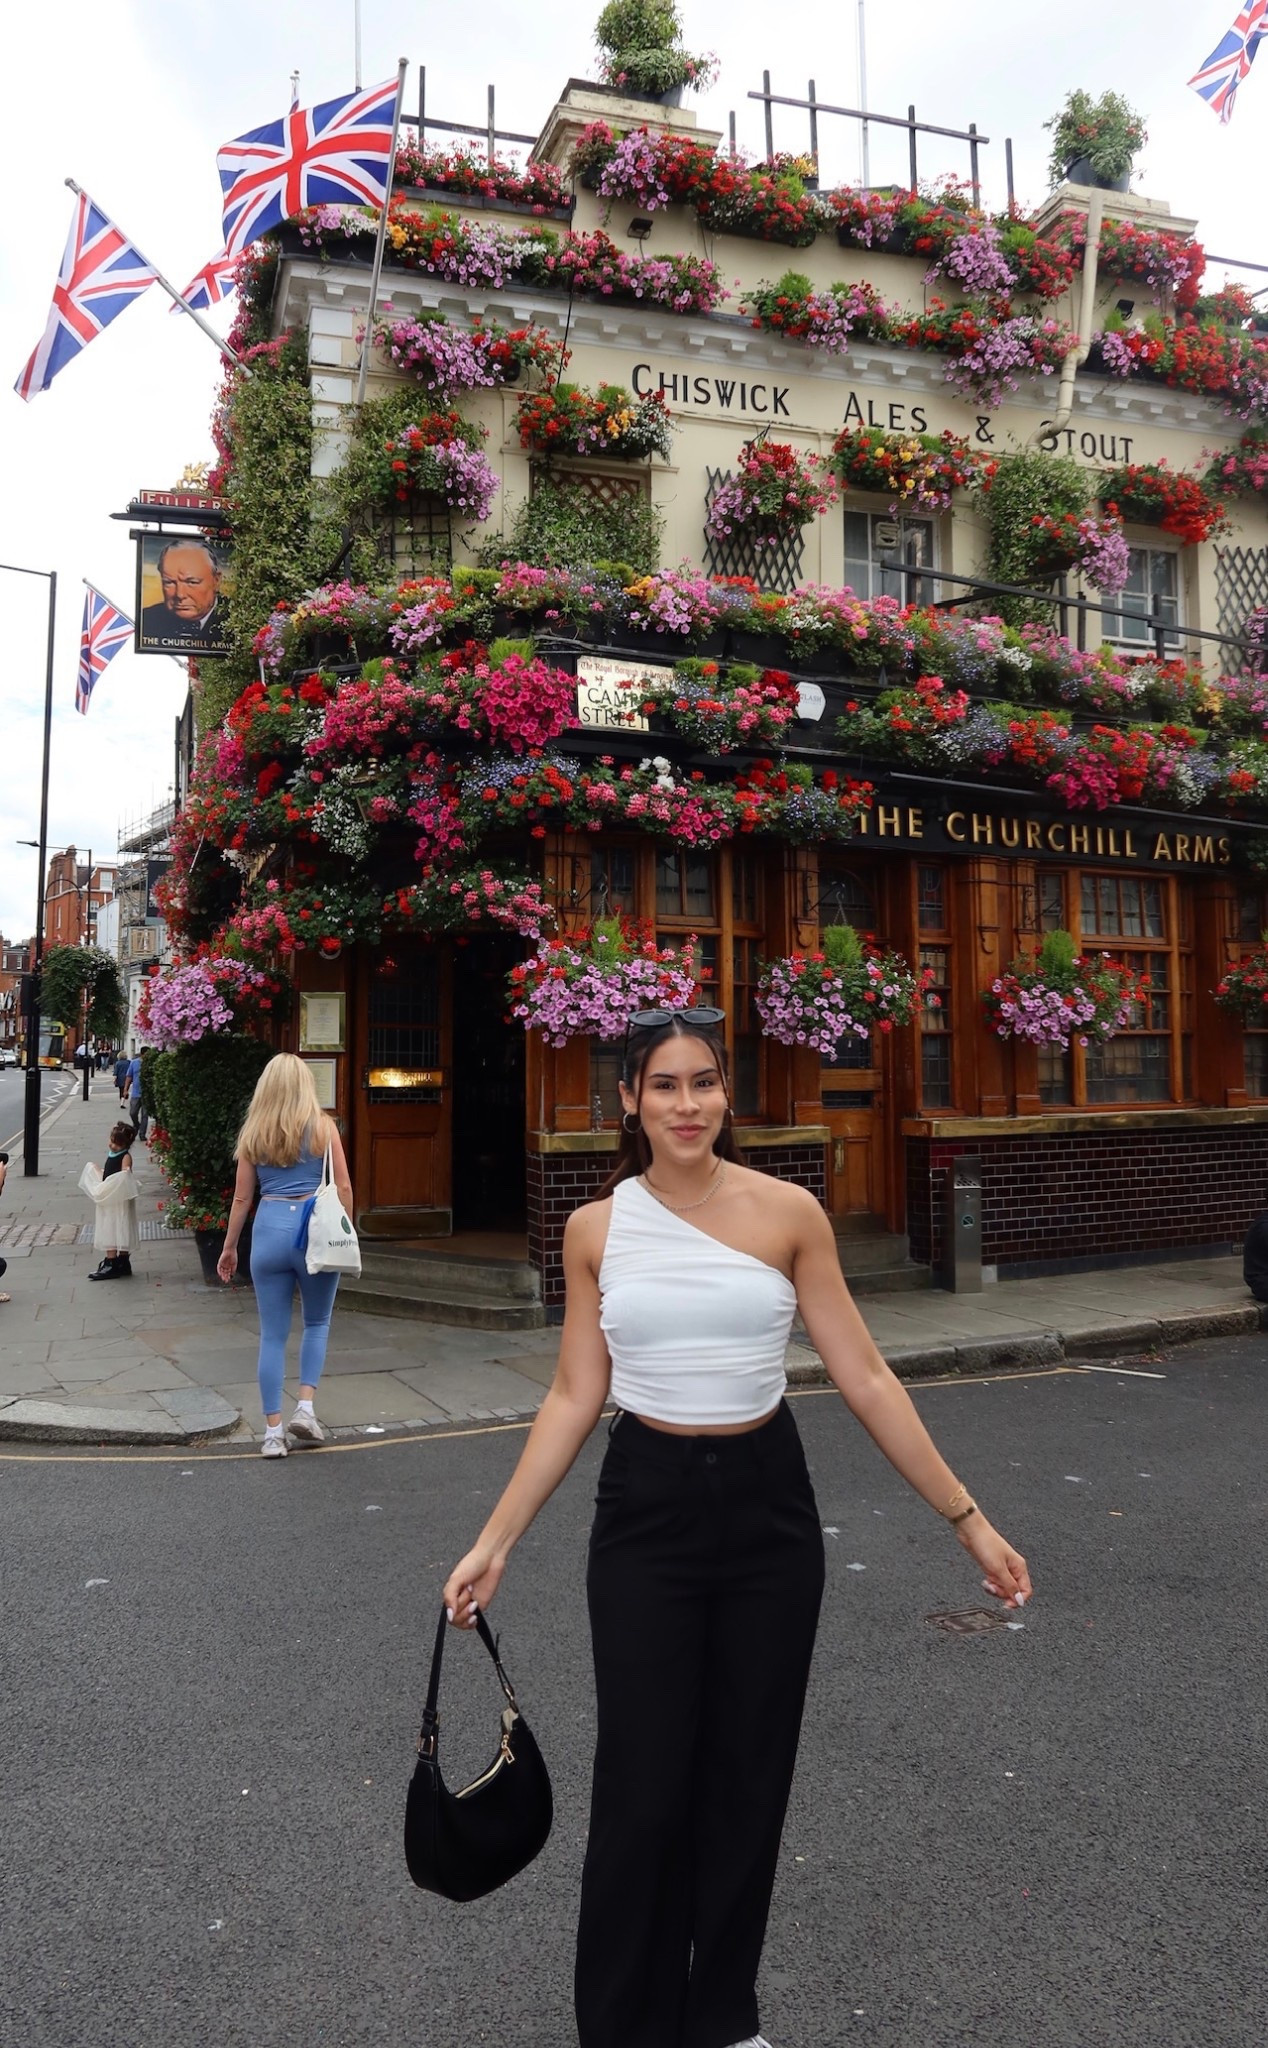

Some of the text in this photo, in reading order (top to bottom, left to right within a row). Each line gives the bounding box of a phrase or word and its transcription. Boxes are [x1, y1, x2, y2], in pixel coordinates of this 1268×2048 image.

[631, 363, 1133, 464] CHISWICK ALES & STOUT
[146, 492, 236, 511] FULLERS
[143, 636, 159, 646] THE
[161, 637, 209, 649] CHURCHILL
[580, 661, 593, 670] The
[594, 662, 612, 675] Royal
[946, 810, 1137, 858] CHURCHILL
[1154, 833, 1230, 865] ARMS
